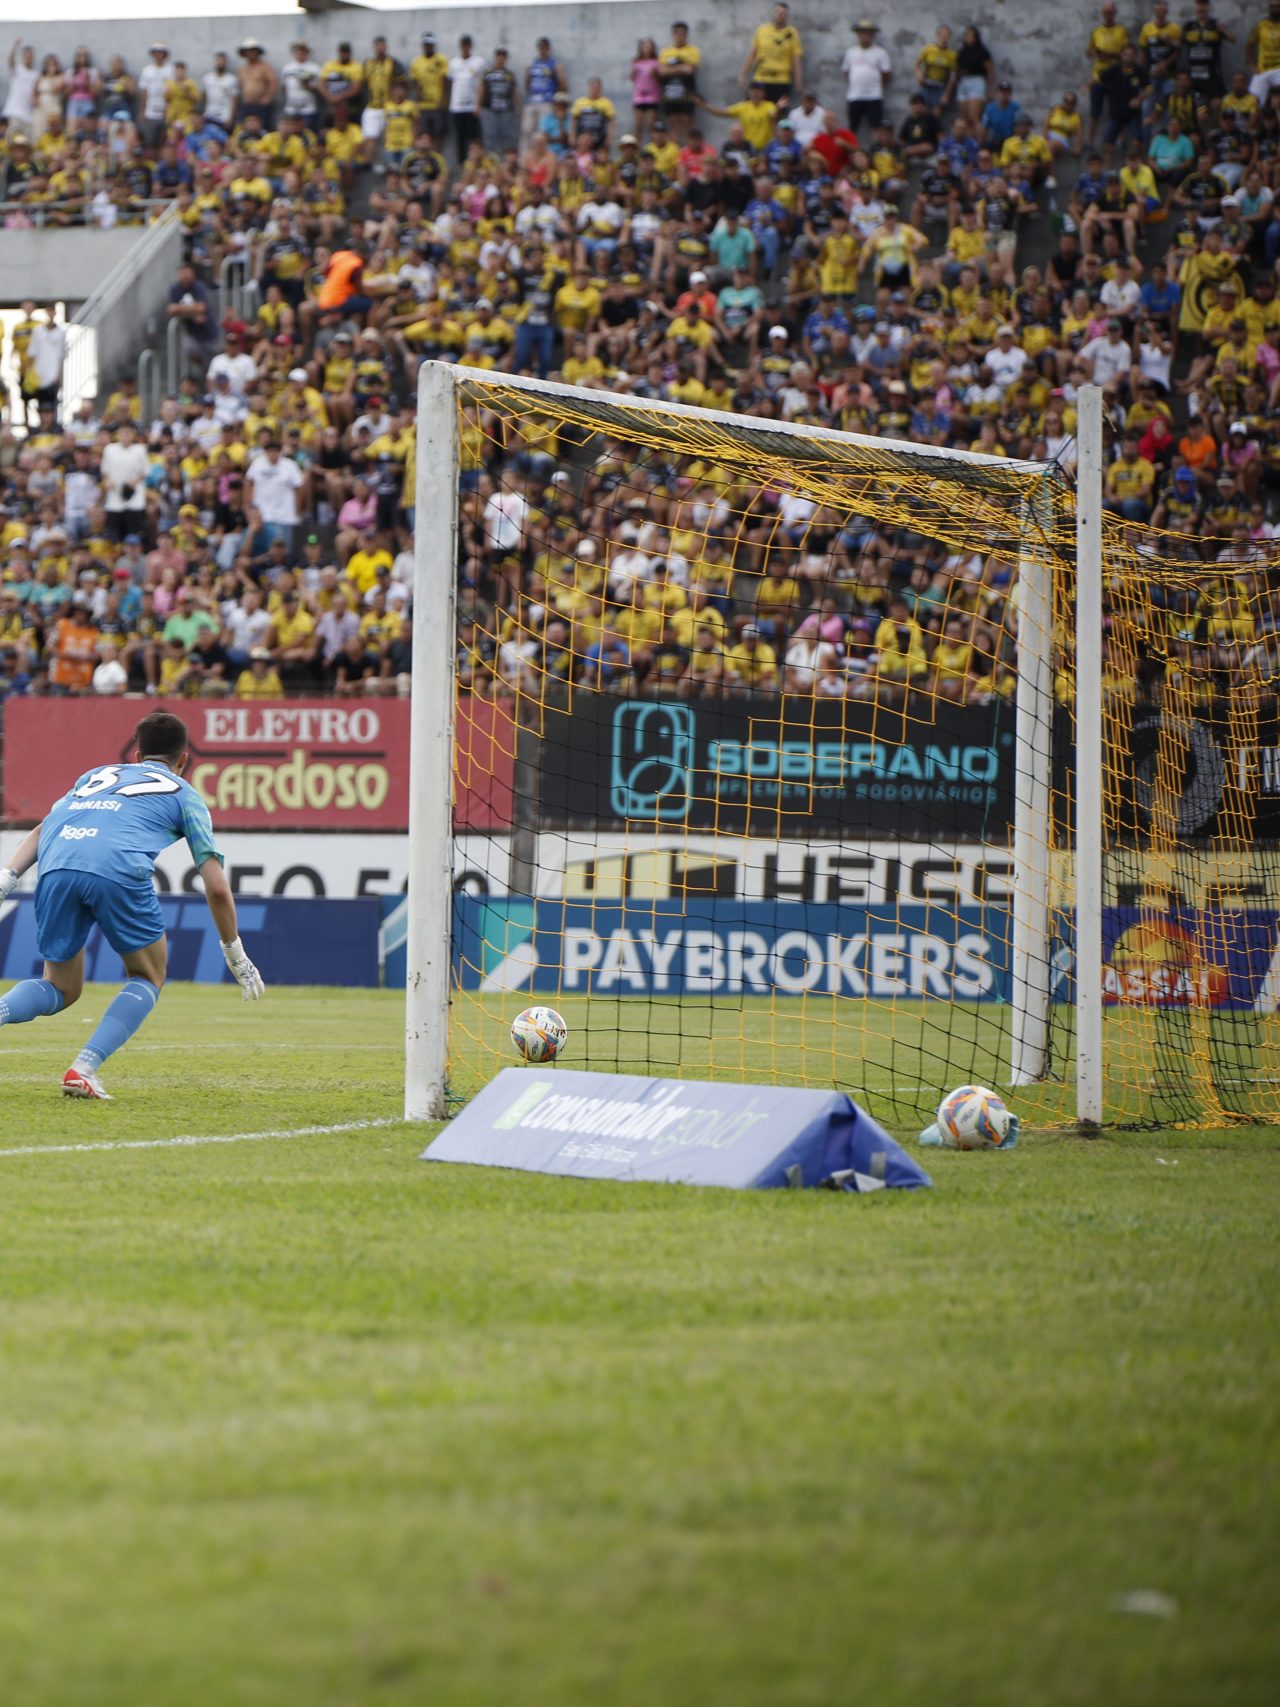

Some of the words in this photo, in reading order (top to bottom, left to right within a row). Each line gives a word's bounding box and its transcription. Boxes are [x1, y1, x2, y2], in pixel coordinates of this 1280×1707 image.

[204, 708, 380, 744] ELETRO
[708, 739, 999, 782] SOBERANO
[68, 800, 122, 811] BENASSI
[563, 926, 994, 994] PAYBROKERS
